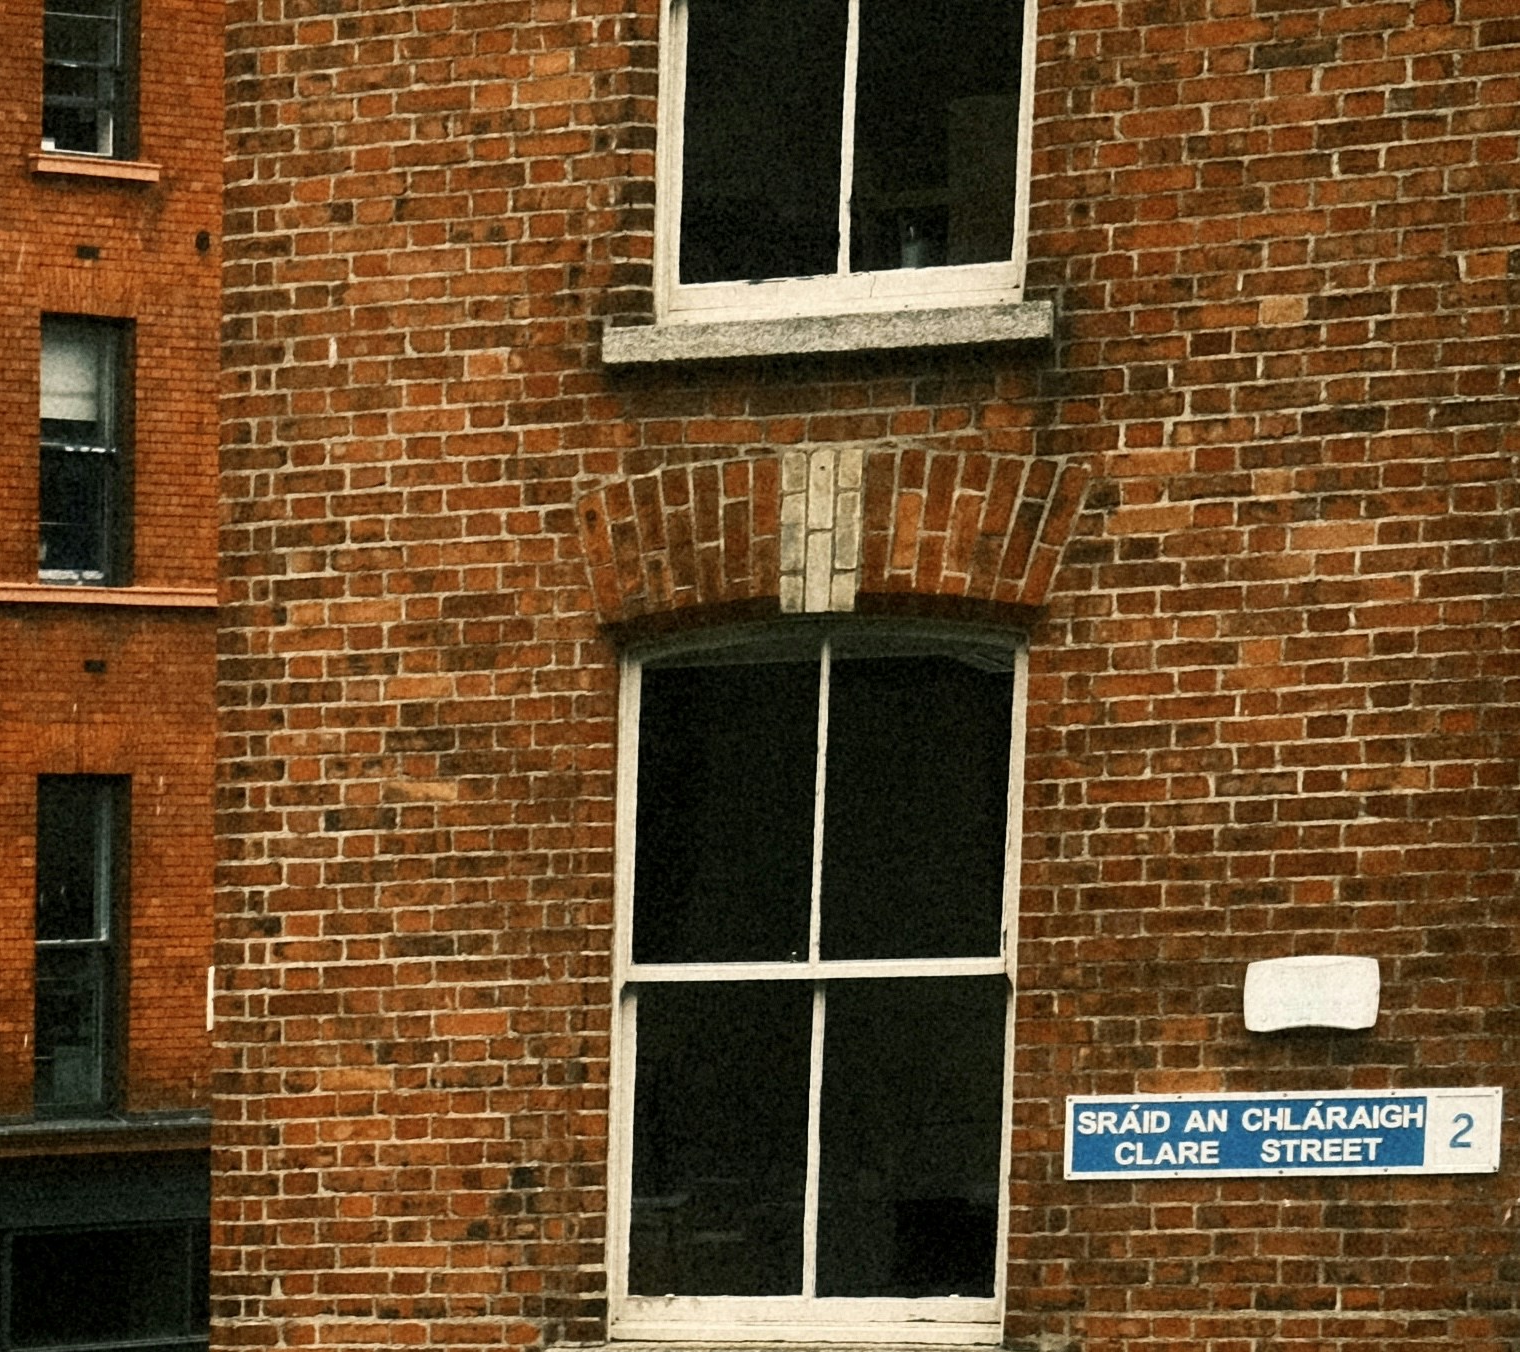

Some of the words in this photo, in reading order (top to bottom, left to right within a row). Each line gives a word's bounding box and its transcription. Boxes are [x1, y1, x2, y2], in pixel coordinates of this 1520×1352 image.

[1077, 1104, 1171, 1137] SRÁID
[1184, 1109, 1228, 1133] AN
[1241, 1101, 1425, 1131] CHLÁRAIGH
[1449, 1112, 1473, 1149] 2
[1114, 1141, 1220, 1166] CLARE
[1260, 1137, 1383, 1163] STREET
